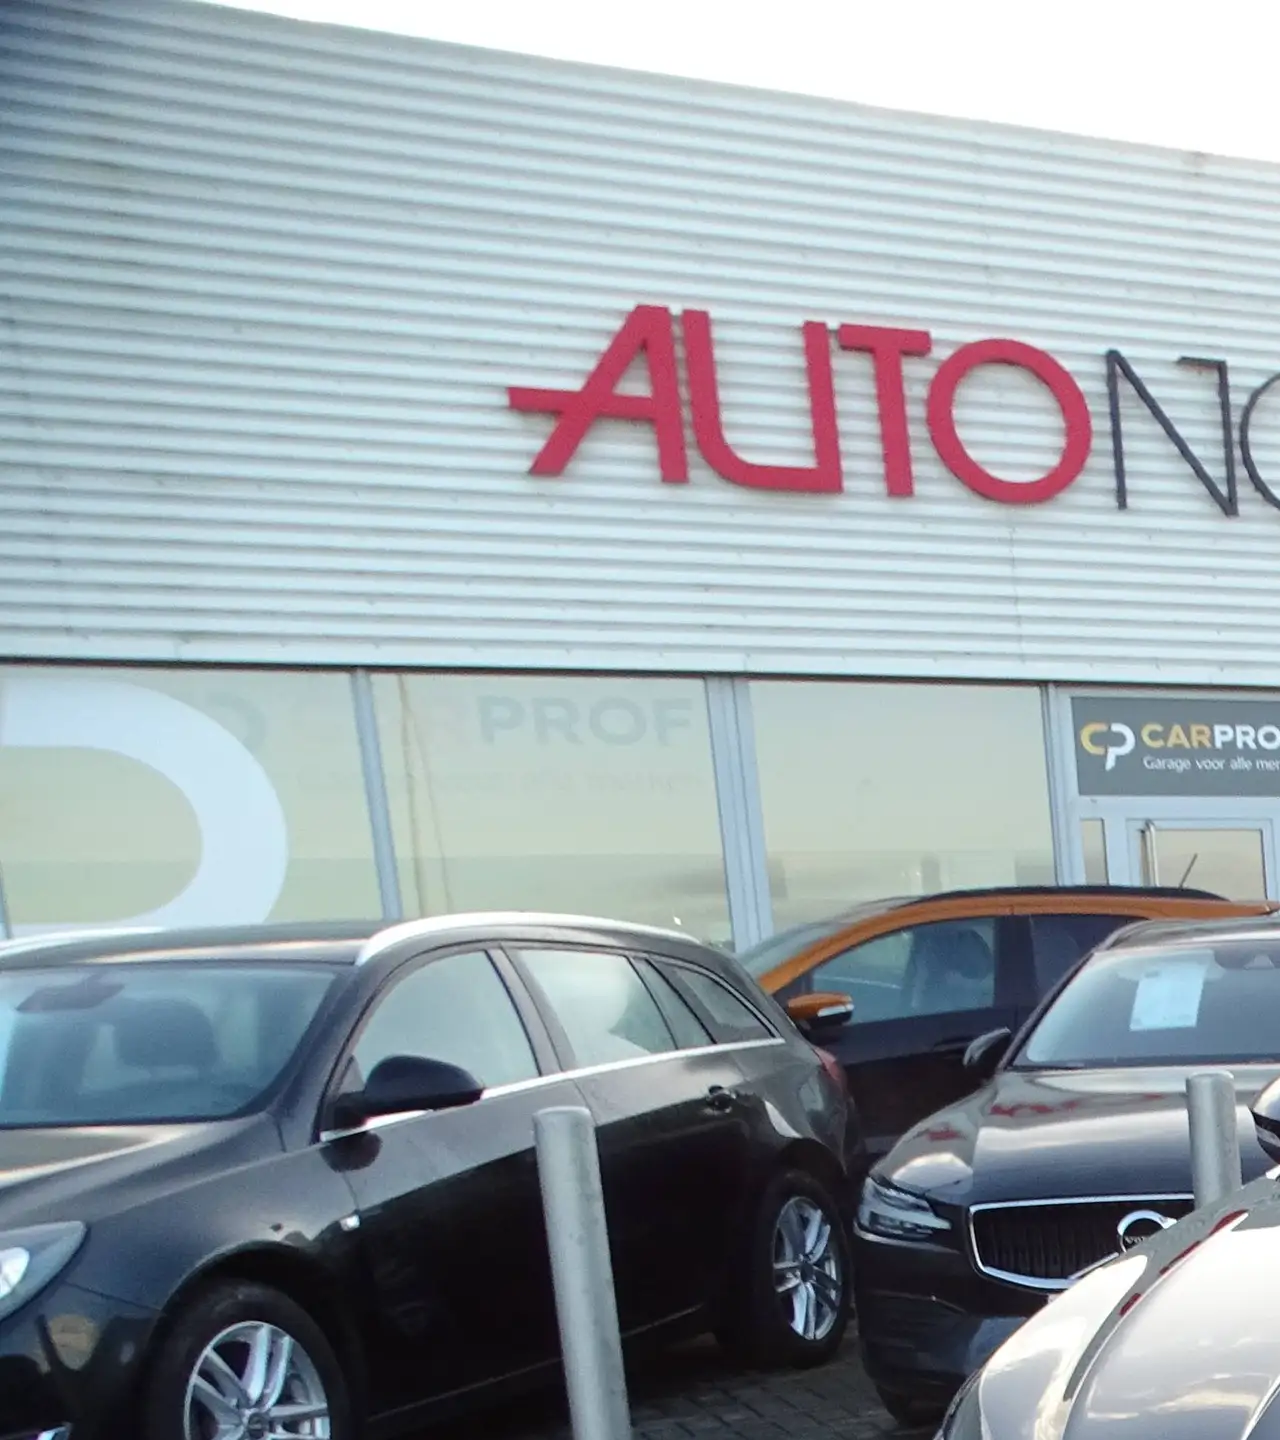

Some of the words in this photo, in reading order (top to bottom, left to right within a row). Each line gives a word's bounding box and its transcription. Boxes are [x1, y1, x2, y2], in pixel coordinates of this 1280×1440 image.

[1143, 756, 1191, 773] Garage
[1196, 759, 1226, 770] voor
[1230, 757, 1253, 771] alle
